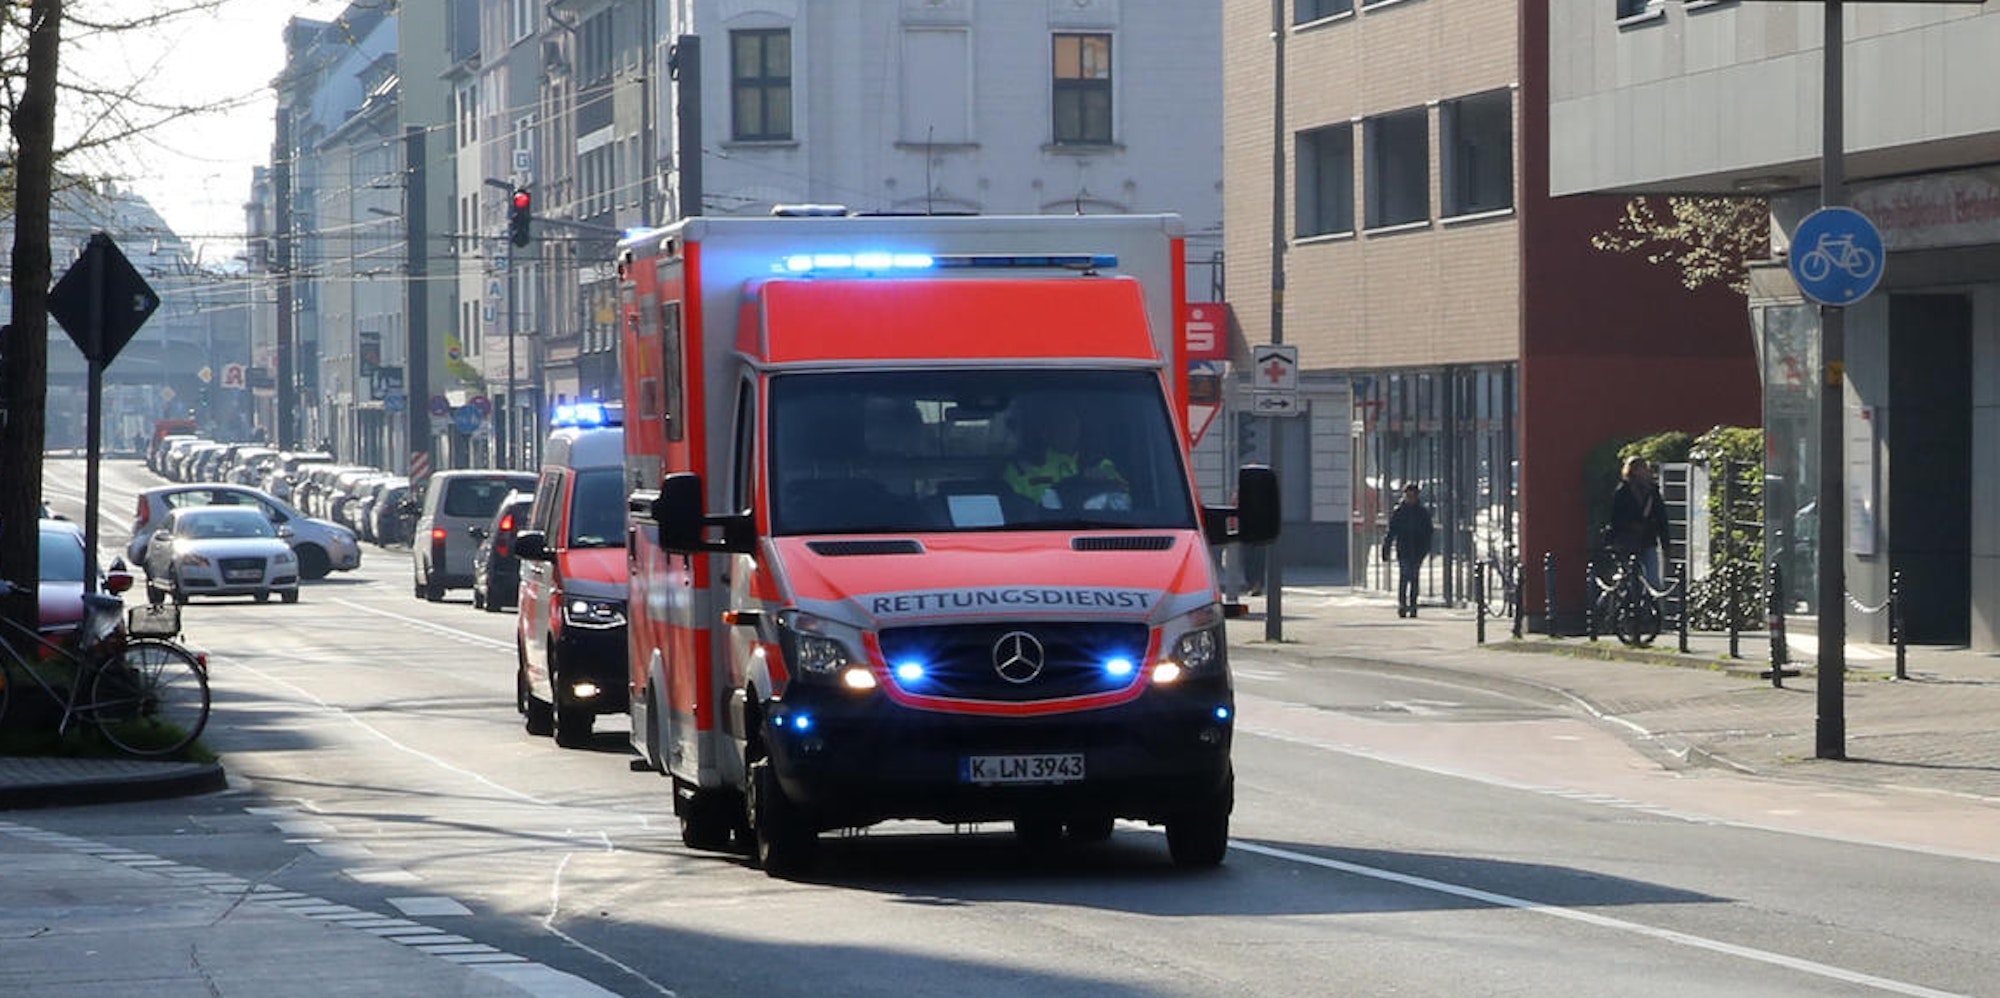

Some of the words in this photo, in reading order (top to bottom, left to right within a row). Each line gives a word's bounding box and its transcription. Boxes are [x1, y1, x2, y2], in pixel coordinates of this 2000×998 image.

[872, 589, 1151, 614] RETTUNGSDIENST
[972, 758, 984, 777] K
[1000, 758, 1028, 777] LN
[1031, 756, 1082, 777] 3943
